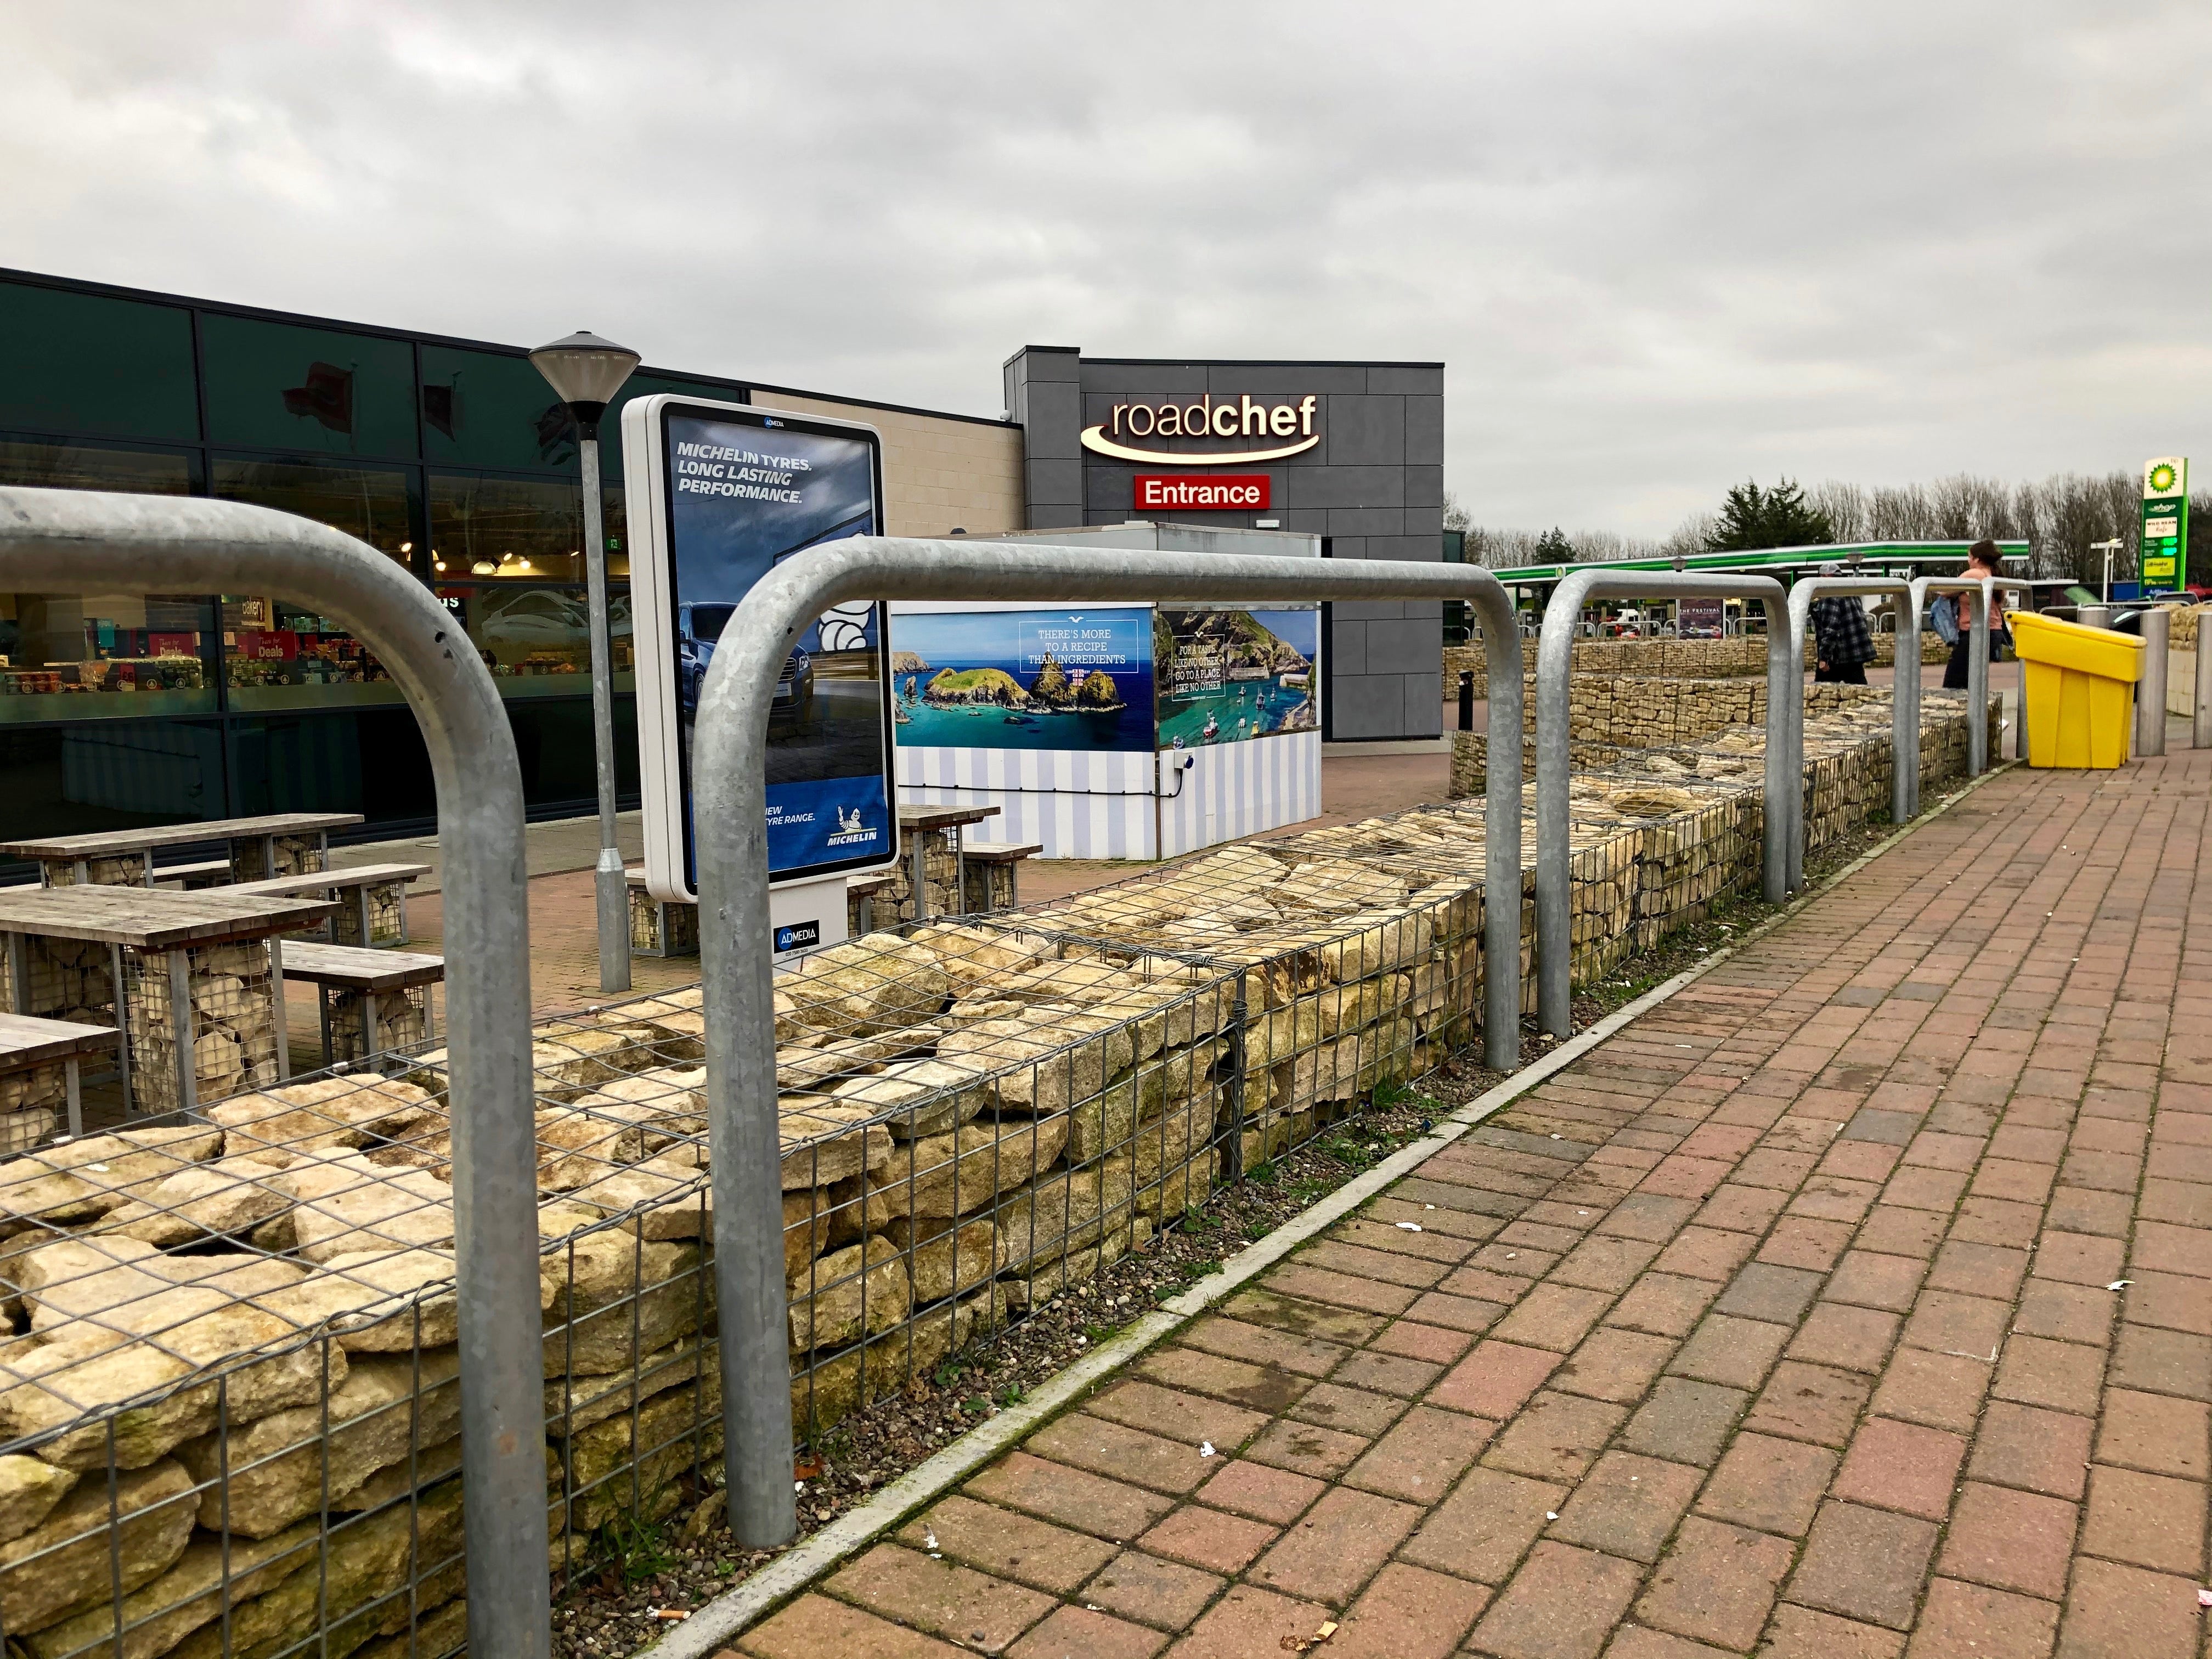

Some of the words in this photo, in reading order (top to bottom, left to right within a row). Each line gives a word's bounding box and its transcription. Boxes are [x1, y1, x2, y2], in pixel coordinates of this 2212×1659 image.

[1112, 394, 1316, 437] roadchef
[677, 442, 759, 464] MICHELIN
[761, 454, 812, 471] TYRES.
[678, 460, 725, 478] LONG
[727, 466, 793, 486] LASTING
[678, 478, 802, 504] PERFORMANCE.
[1145, 481, 1260, 504] Entrance
[1038, 629, 1079, 639] THERE'S
[1081, 629, 1111, 639] MORE
[258, 645, 284, 657] Deals
[1045, 642, 1059, 652] TO
[1062, 642, 1069, 651] A
[1071, 642, 1107, 651] RECIPE
[1180, 646, 1192, 655] FOR
[1192, 645, 1197, 654] A
[1198, 645, 1216, 654] TASTE
[1028, 655, 1054, 664] THAN
[1057, 654, 1126, 664] INGREDIENTS
[1175, 658, 1188, 668] LIKE
[1189, 658, 1198, 667] NO
[1175, 671, 1185, 681] GO
[1186, 670, 1194, 680] TO
[1195, 670, 1200, 679] A
[1200, 668, 1220, 678] PLACE
[1176, 684, 1189, 693] LIKE
[1189, 682, 1199, 692] NO
[1200, 681, 1221, 691] OTHER
[784, 812, 816, 824] RANGE.
[827, 832, 877, 847] MICHELIN
[781, 928, 816, 944] ADMEDIA
